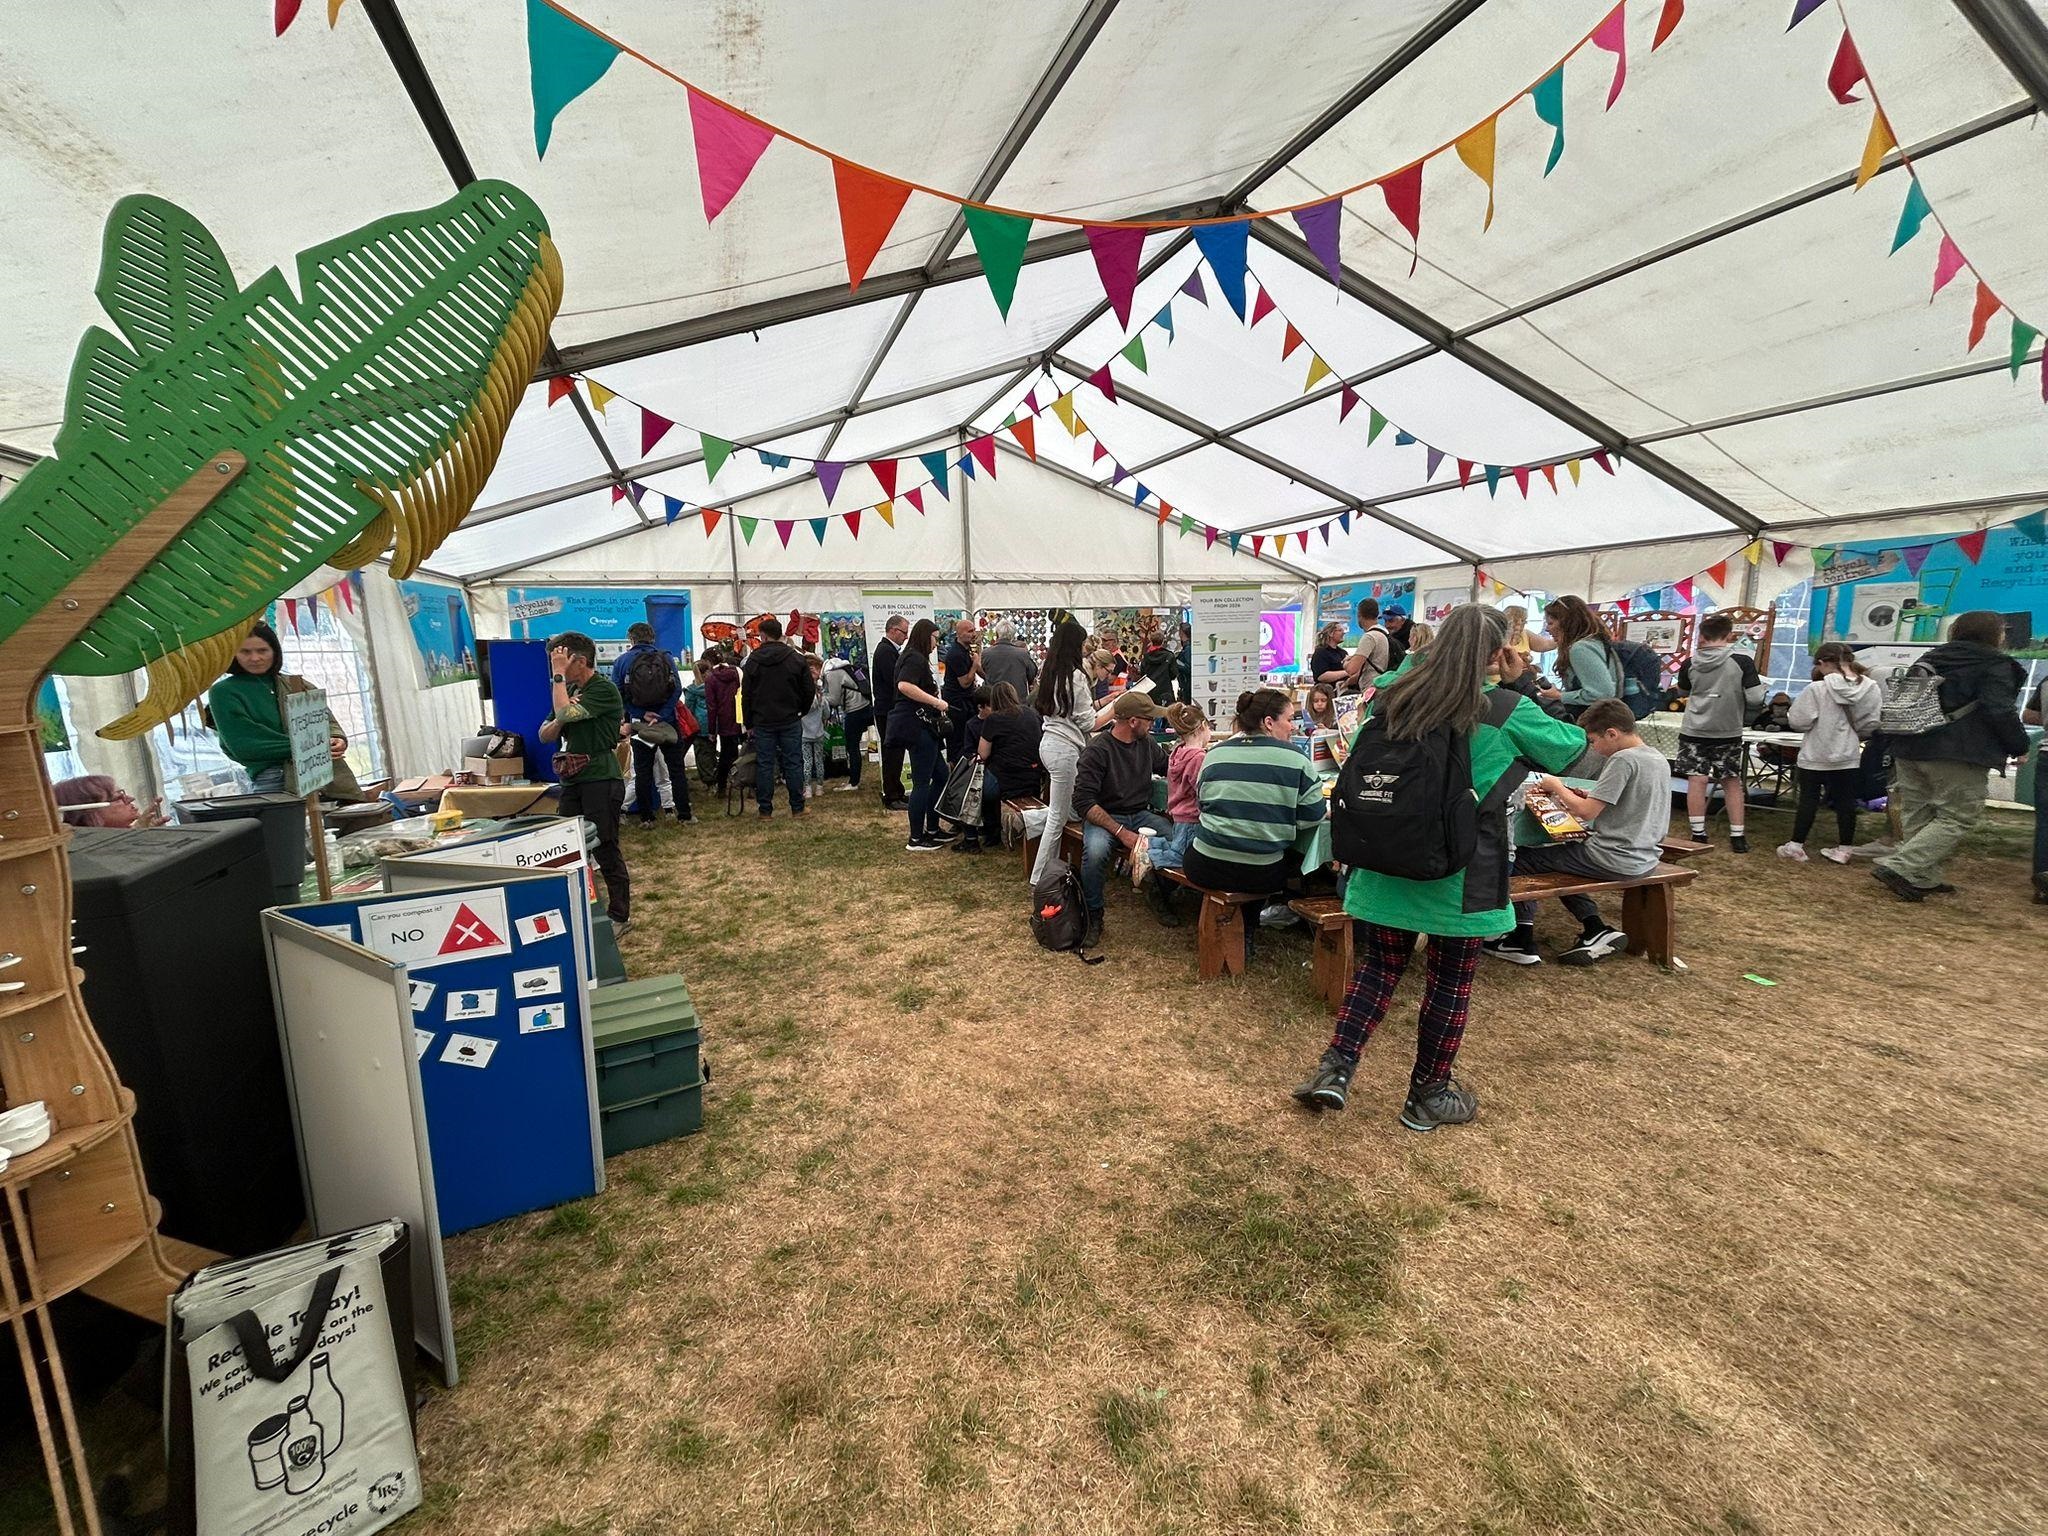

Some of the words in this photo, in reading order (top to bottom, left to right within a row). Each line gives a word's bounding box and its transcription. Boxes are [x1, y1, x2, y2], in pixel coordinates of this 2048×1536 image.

[514, 600, 554, 612] recycling
[529, 608, 548, 616] home
[516, 843, 568, 867] Browns
[388, 912, 400, 920] you
[402, 907, 432, 918] compost
[391, 929, 424, 944] NO
[208, 1323, 283, 1372] Recle
[288, 1285, 361, 1328] Toay!
[200, 1378, 221, 1397] We
[225, 1362, 250, 1382] cou
[329, 1314, 348, 1329] on
[351, 1302, 374, 1319] the
[217, 1372, 256, 1402] shelv
[317, 1323, 357, 1349] days!
[290, 1437, 315, 1456] 100%
[376, 1483, 399, 1499] IRS
